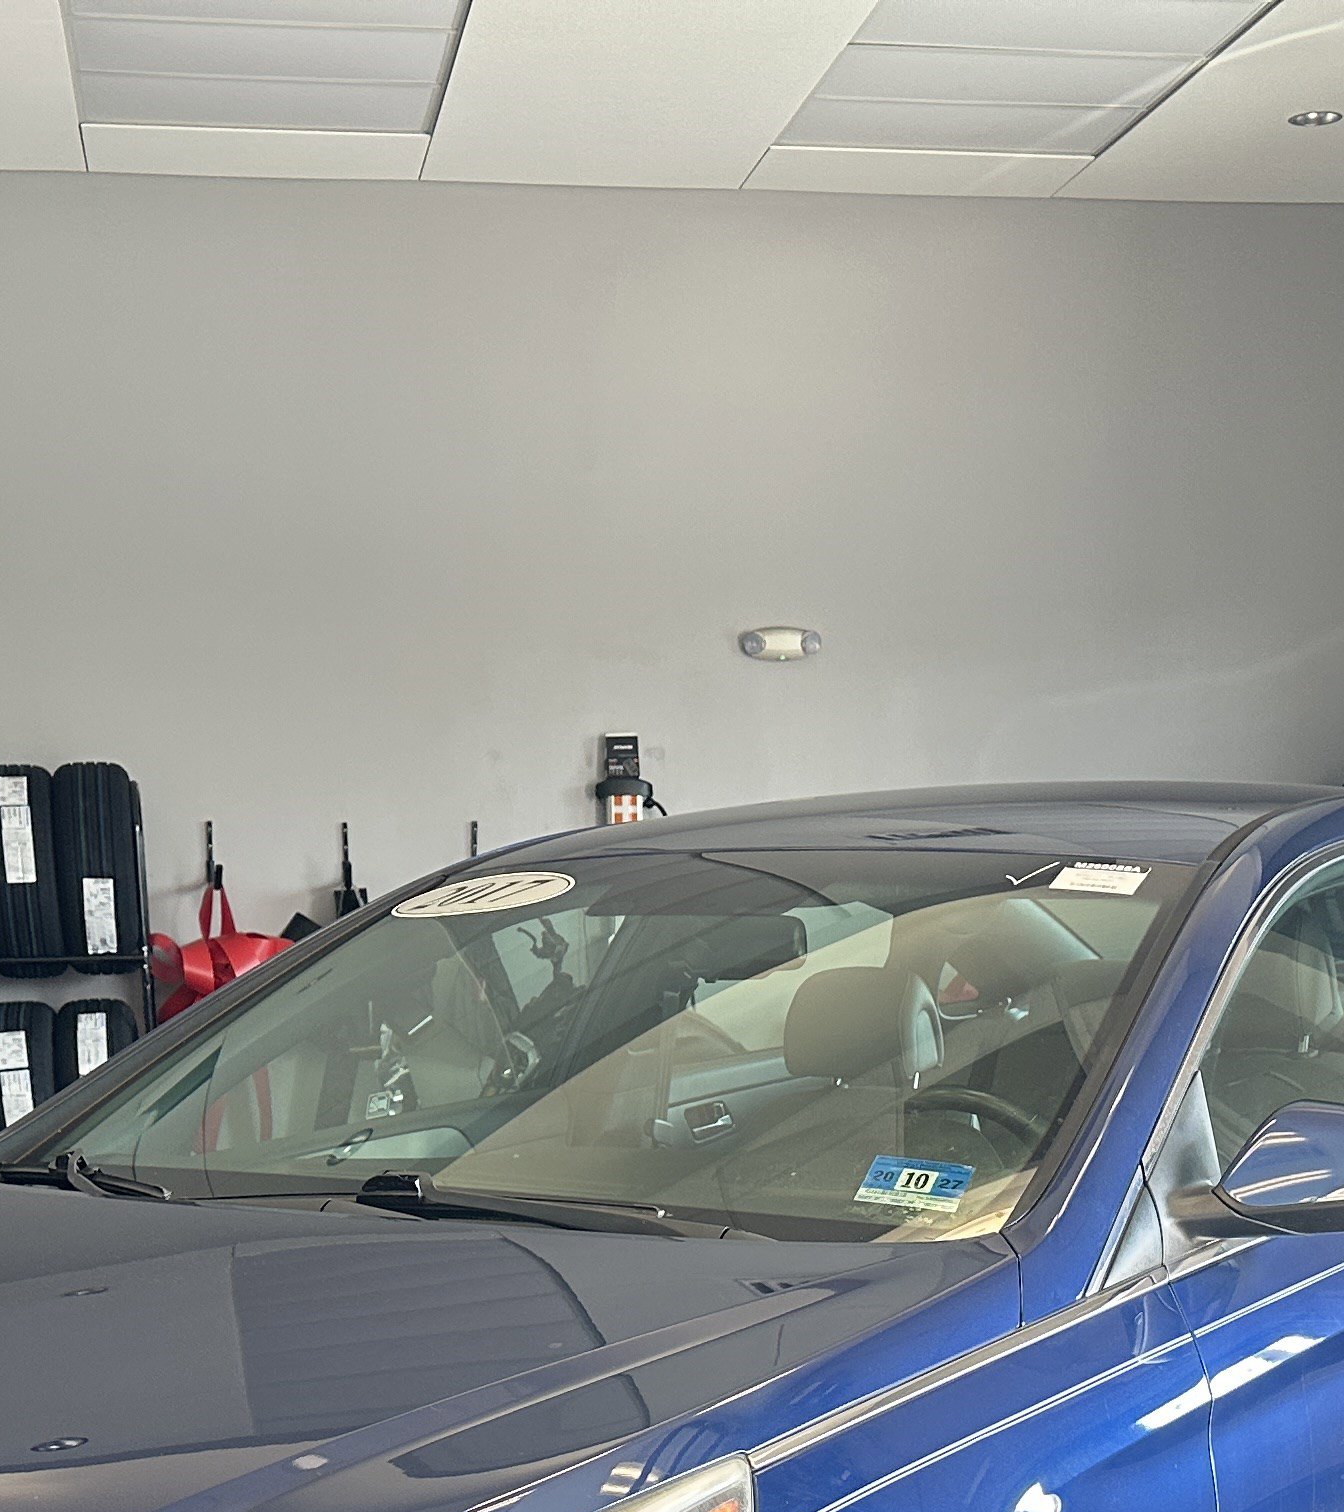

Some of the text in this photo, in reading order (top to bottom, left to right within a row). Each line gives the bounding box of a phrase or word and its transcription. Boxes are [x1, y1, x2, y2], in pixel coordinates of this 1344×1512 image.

[405, 878, 558, 912] 2017
[873, 1170, 964, 1190] 20 10 27
